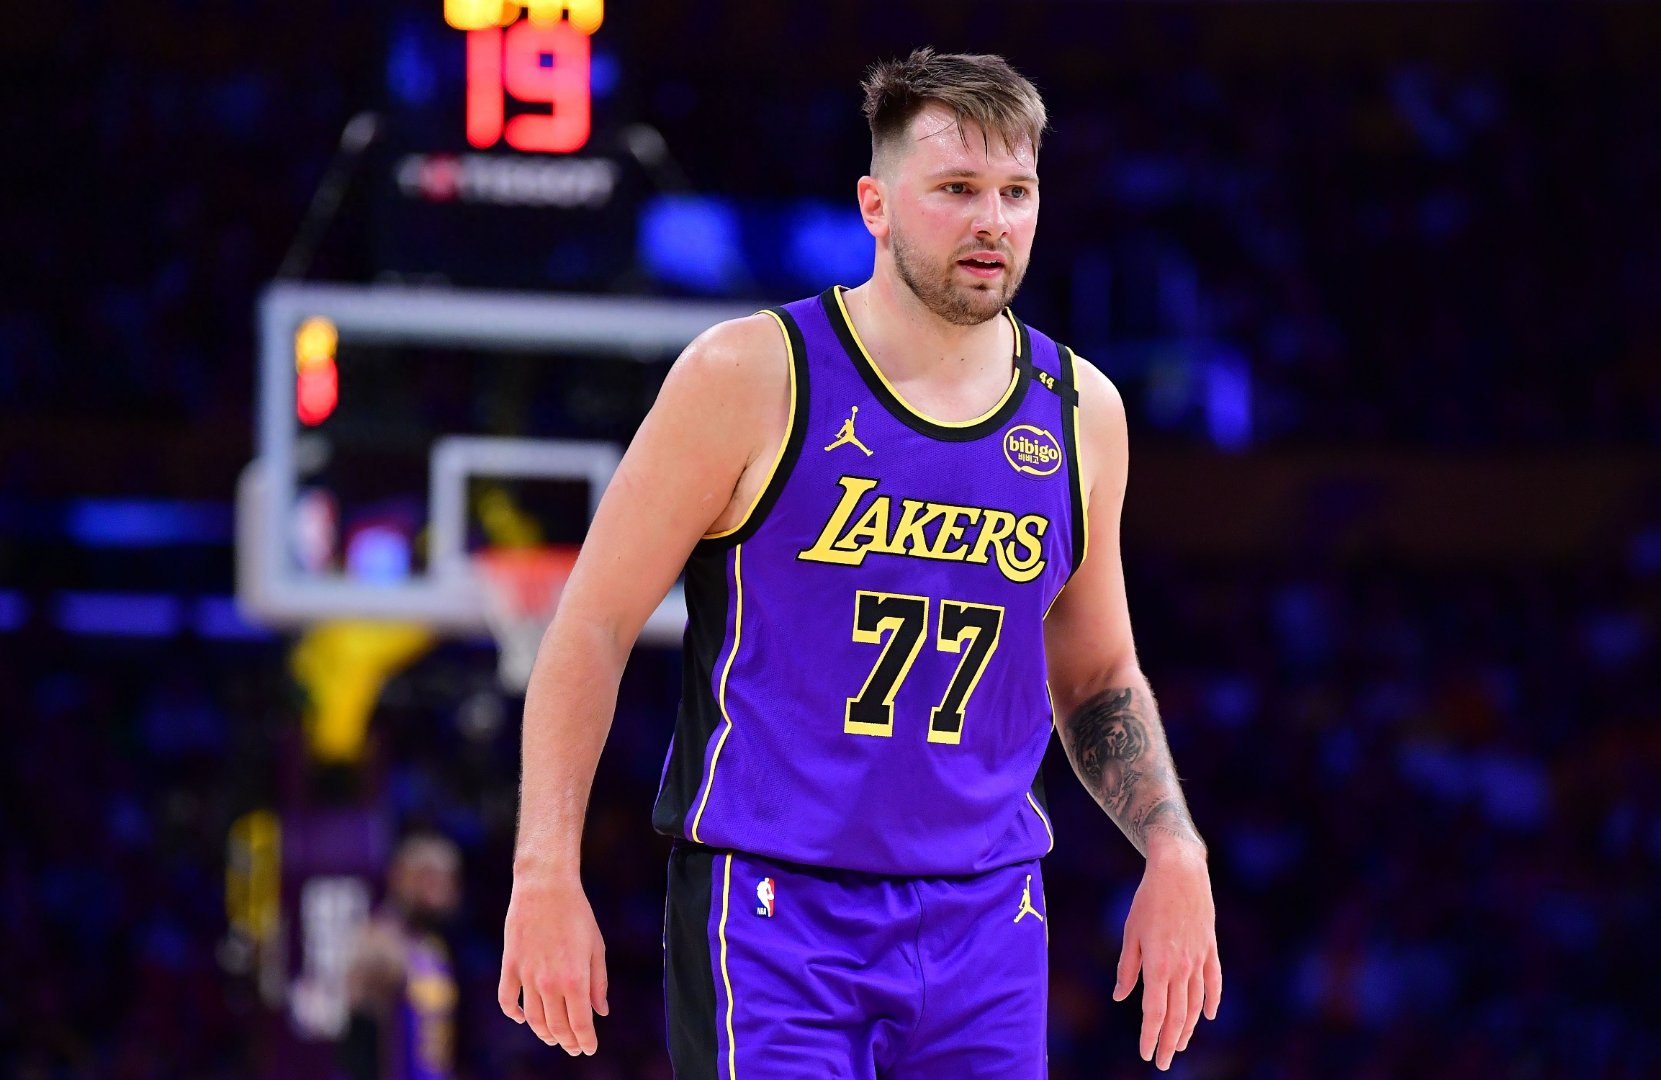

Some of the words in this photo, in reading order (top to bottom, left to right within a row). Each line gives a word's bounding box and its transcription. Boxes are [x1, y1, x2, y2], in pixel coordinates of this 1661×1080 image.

[465, 18, 591, 153] 19
[1039, 371, 1055, 389] 44
[1009, 435, 1058, 463] bibigo
[1018, 453, 1039, 464] 비비고
[796, 475, 1050, 583] LAKERS
[844, 590, 1005, 744] 77
